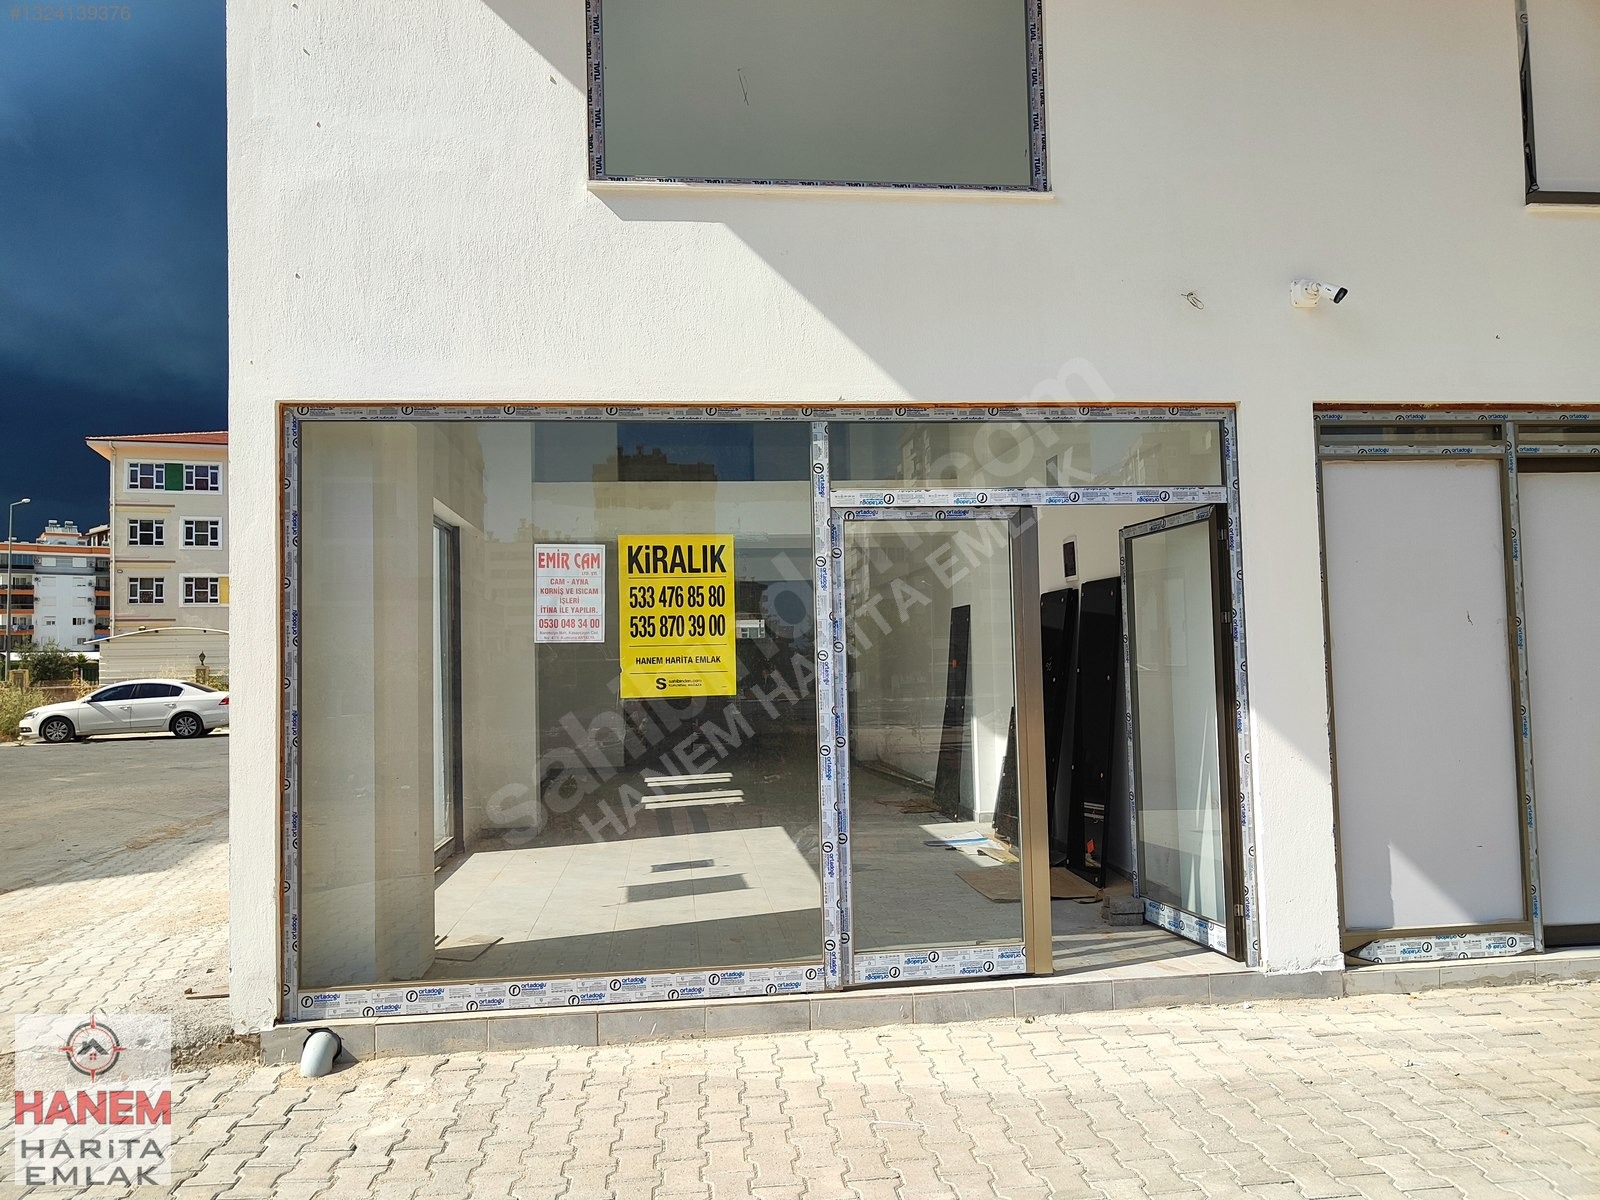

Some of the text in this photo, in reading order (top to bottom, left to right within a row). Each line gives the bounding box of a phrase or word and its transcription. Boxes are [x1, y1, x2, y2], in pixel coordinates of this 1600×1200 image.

[538, 549, 600, 570] EMİR CAM
[540, 586, 564, 595] KORNİŞ
[559, 596, 580, 605] İŞLERİ
[629, 585, 726, 609] 533 476 85 80
[540, 606, 558, 614] İTİNA
[559, 606, 569, 614] İLE
[539, 618, 600, 629] 0530 048 34 00
[630, 614, 726, 638] 535 870 39 00
[635, 655, 721, 665] HANEM HARİTA EMLAK
[720, 970, 745, 978] ortadoğu
[621, 976, 647, 984] ortadoğu
[777, 981, 802, 989] ortadoğu
[418, 987, 445, 995] ortadoğu
[679, 987, 705, 995] ortadoğu
[314, 993, 340, 1001] ortadoğu
[580, 992, 606, 1000] ortadoğu
[479, 998, 505, 1006] ortadoğu
